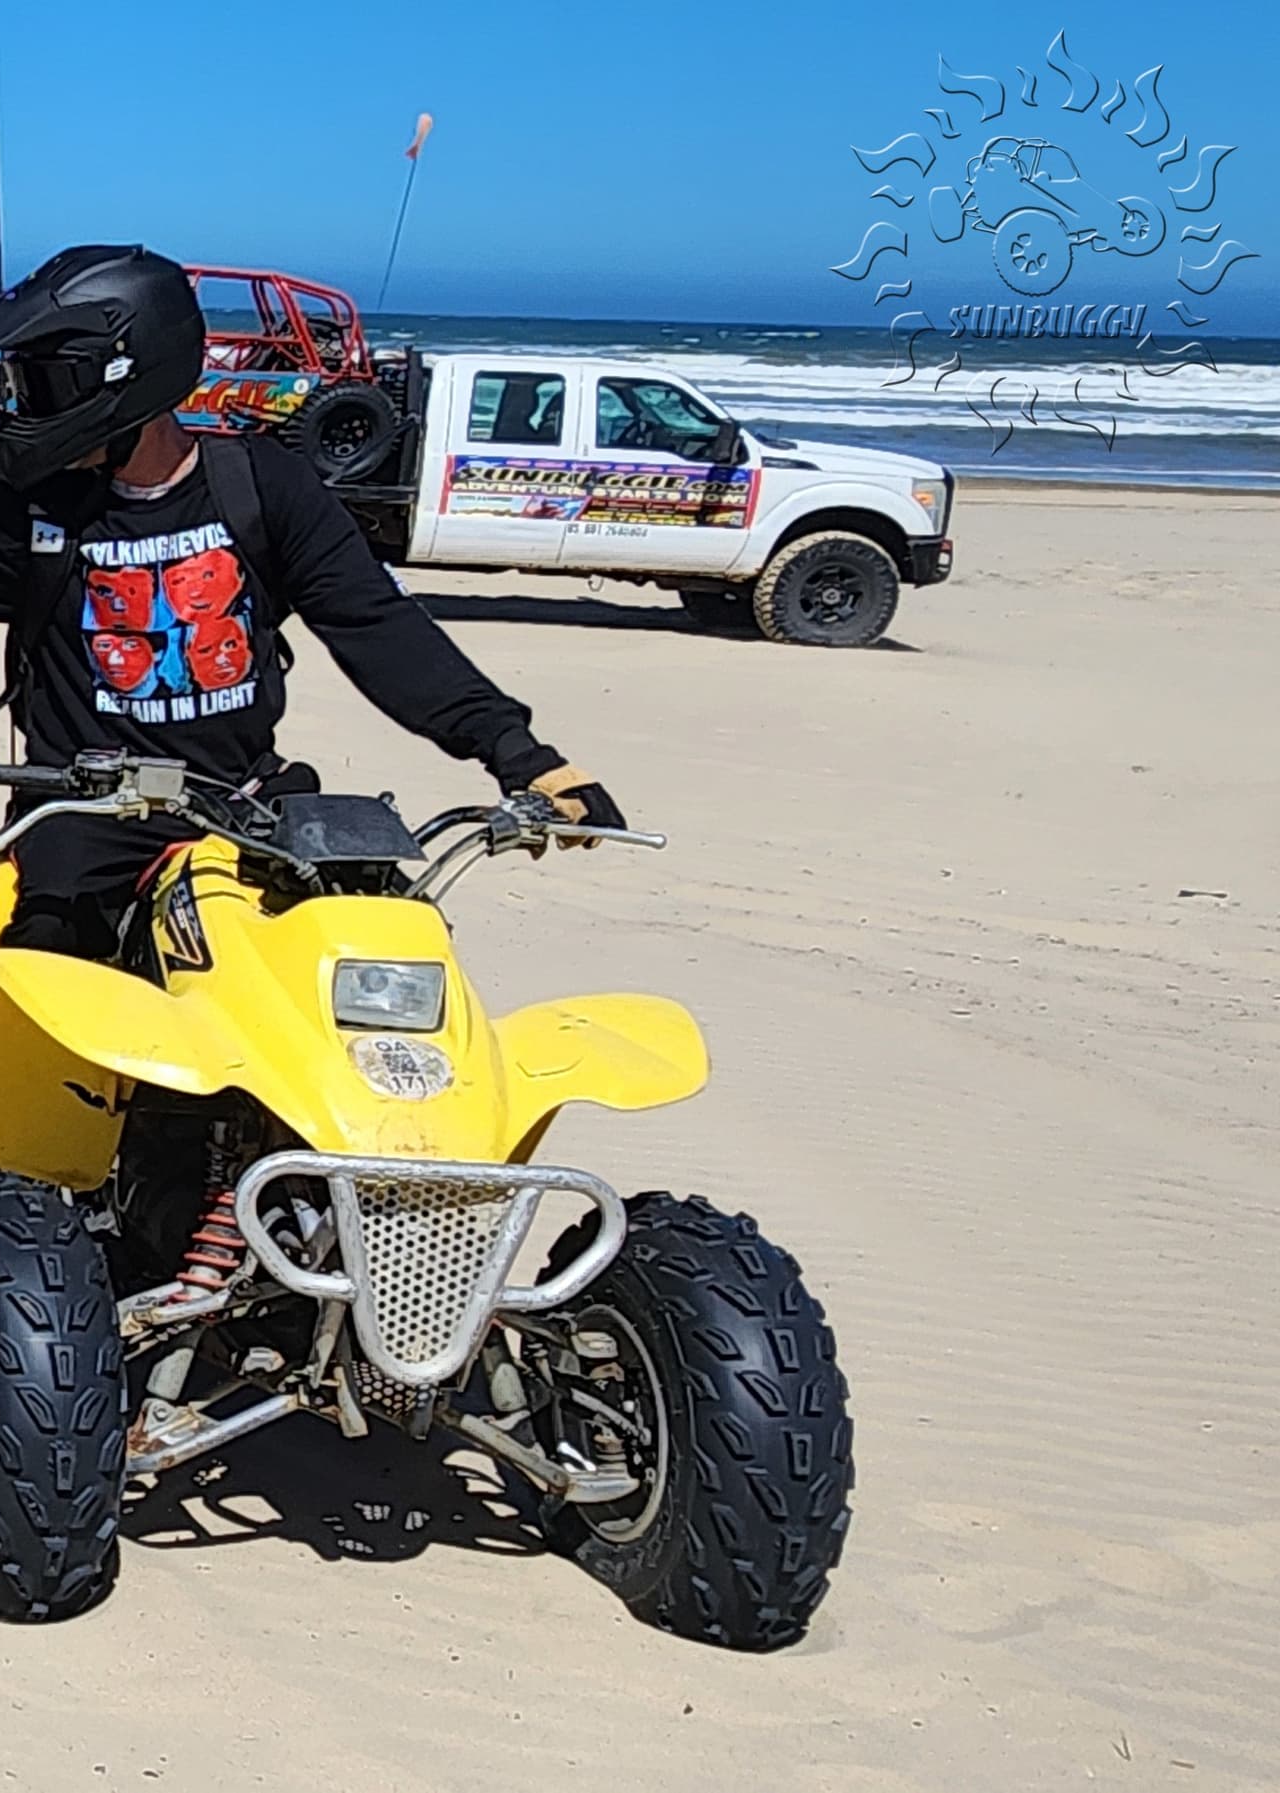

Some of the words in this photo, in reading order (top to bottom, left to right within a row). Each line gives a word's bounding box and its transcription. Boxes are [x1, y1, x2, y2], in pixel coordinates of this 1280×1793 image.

[171, 694, 196, 721] IN
[200, 681, 256, 717] LIGHT
[391, 1075, 427, 1090] 171
